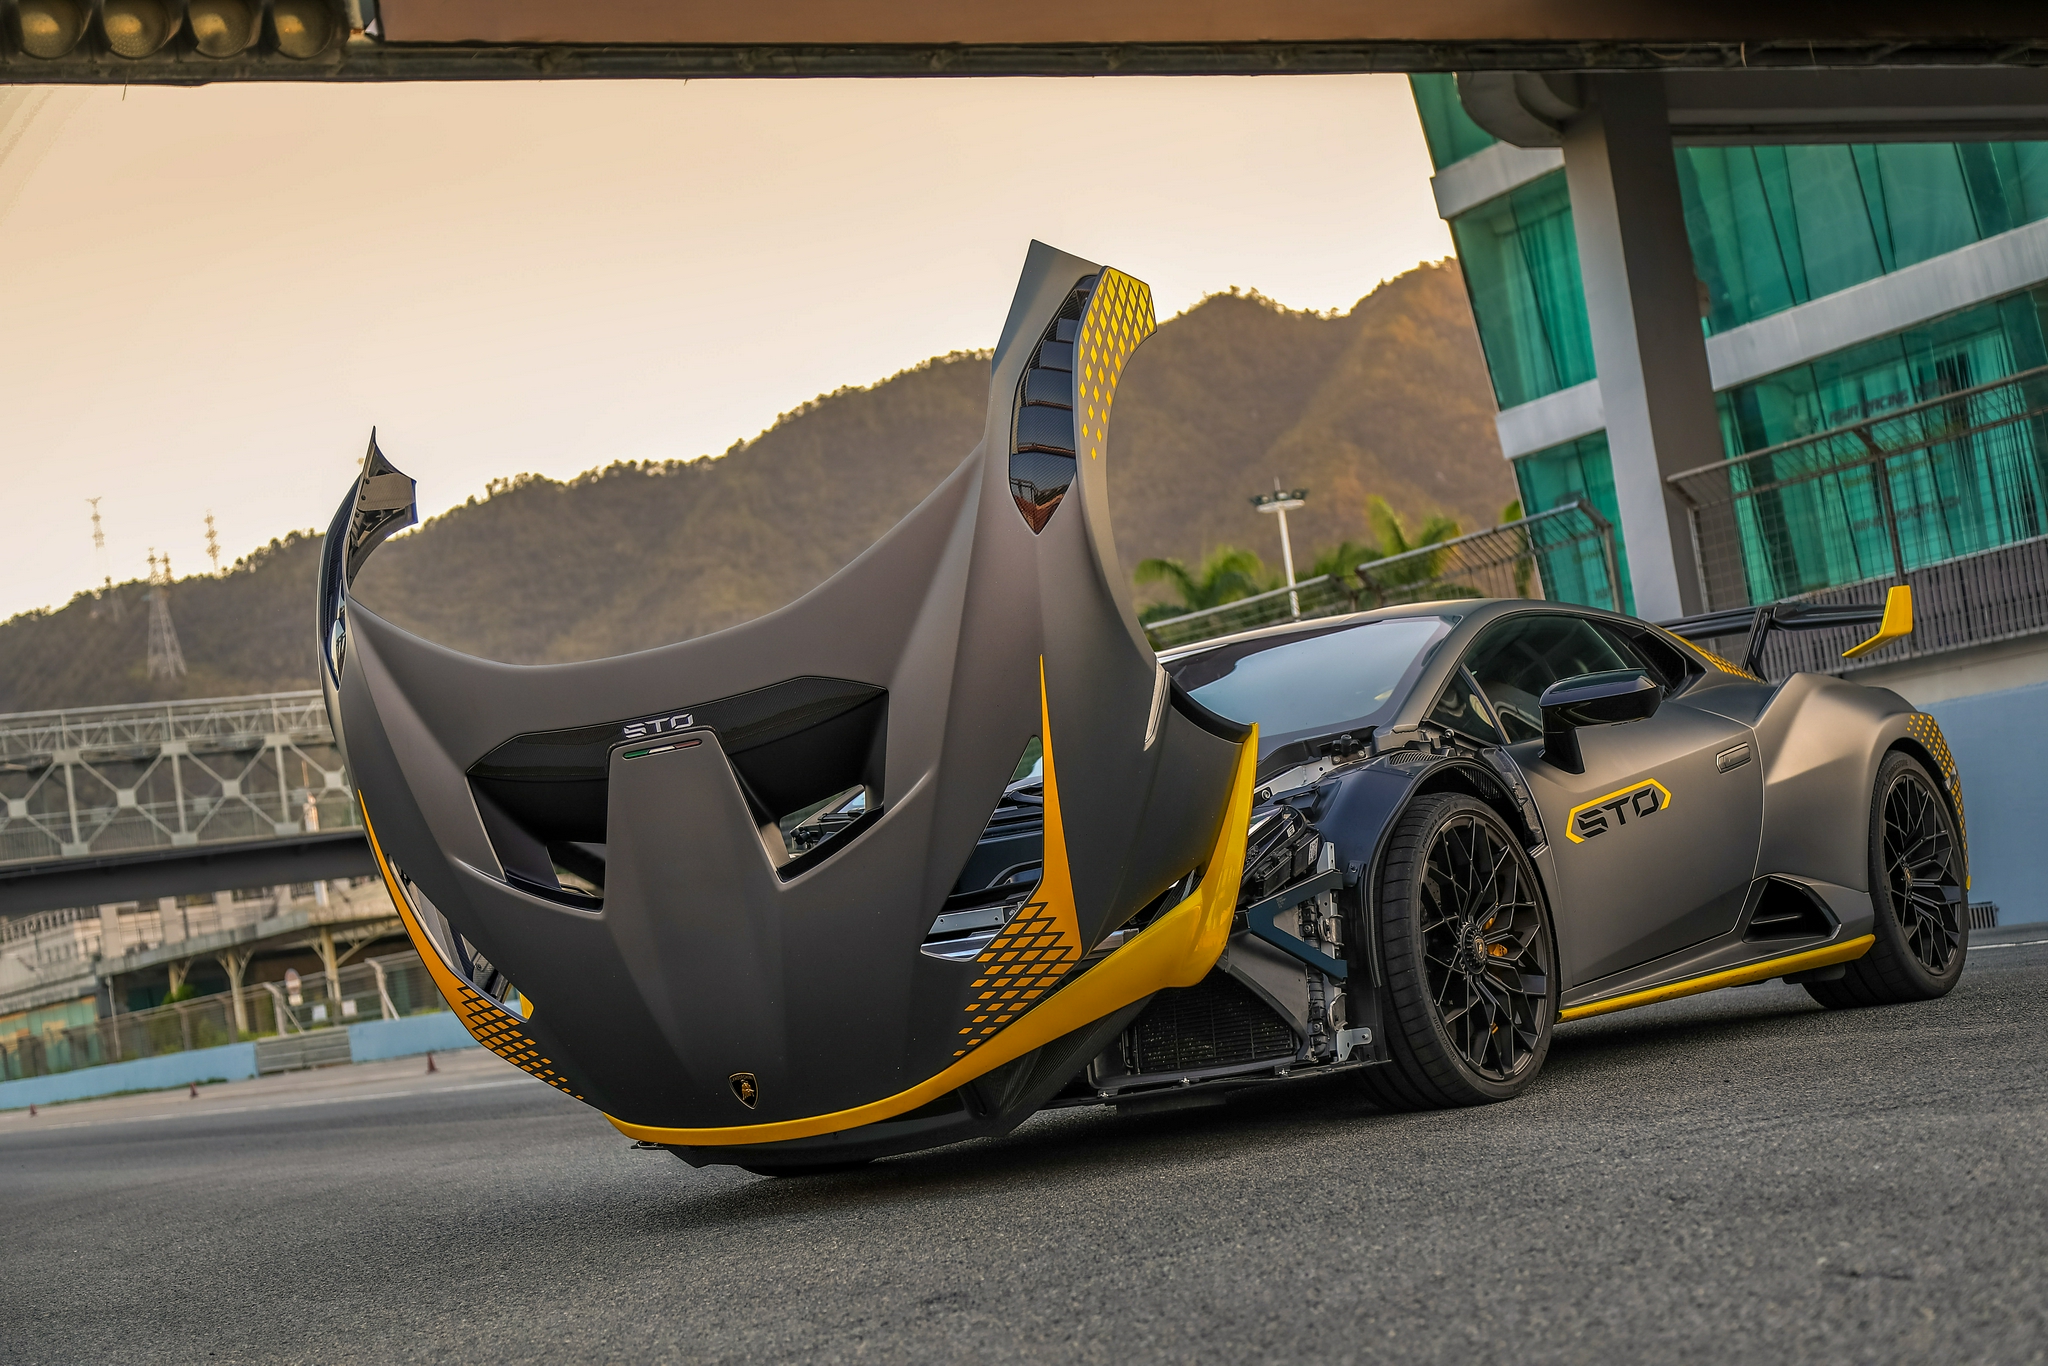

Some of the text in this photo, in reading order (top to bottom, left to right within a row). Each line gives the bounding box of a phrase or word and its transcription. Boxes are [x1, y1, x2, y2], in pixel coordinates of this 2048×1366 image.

[623, 713, 694, 738] STO
[1577, 788, 1659, 838] STO
[1422, 819, 1438, 849] POTENZA
